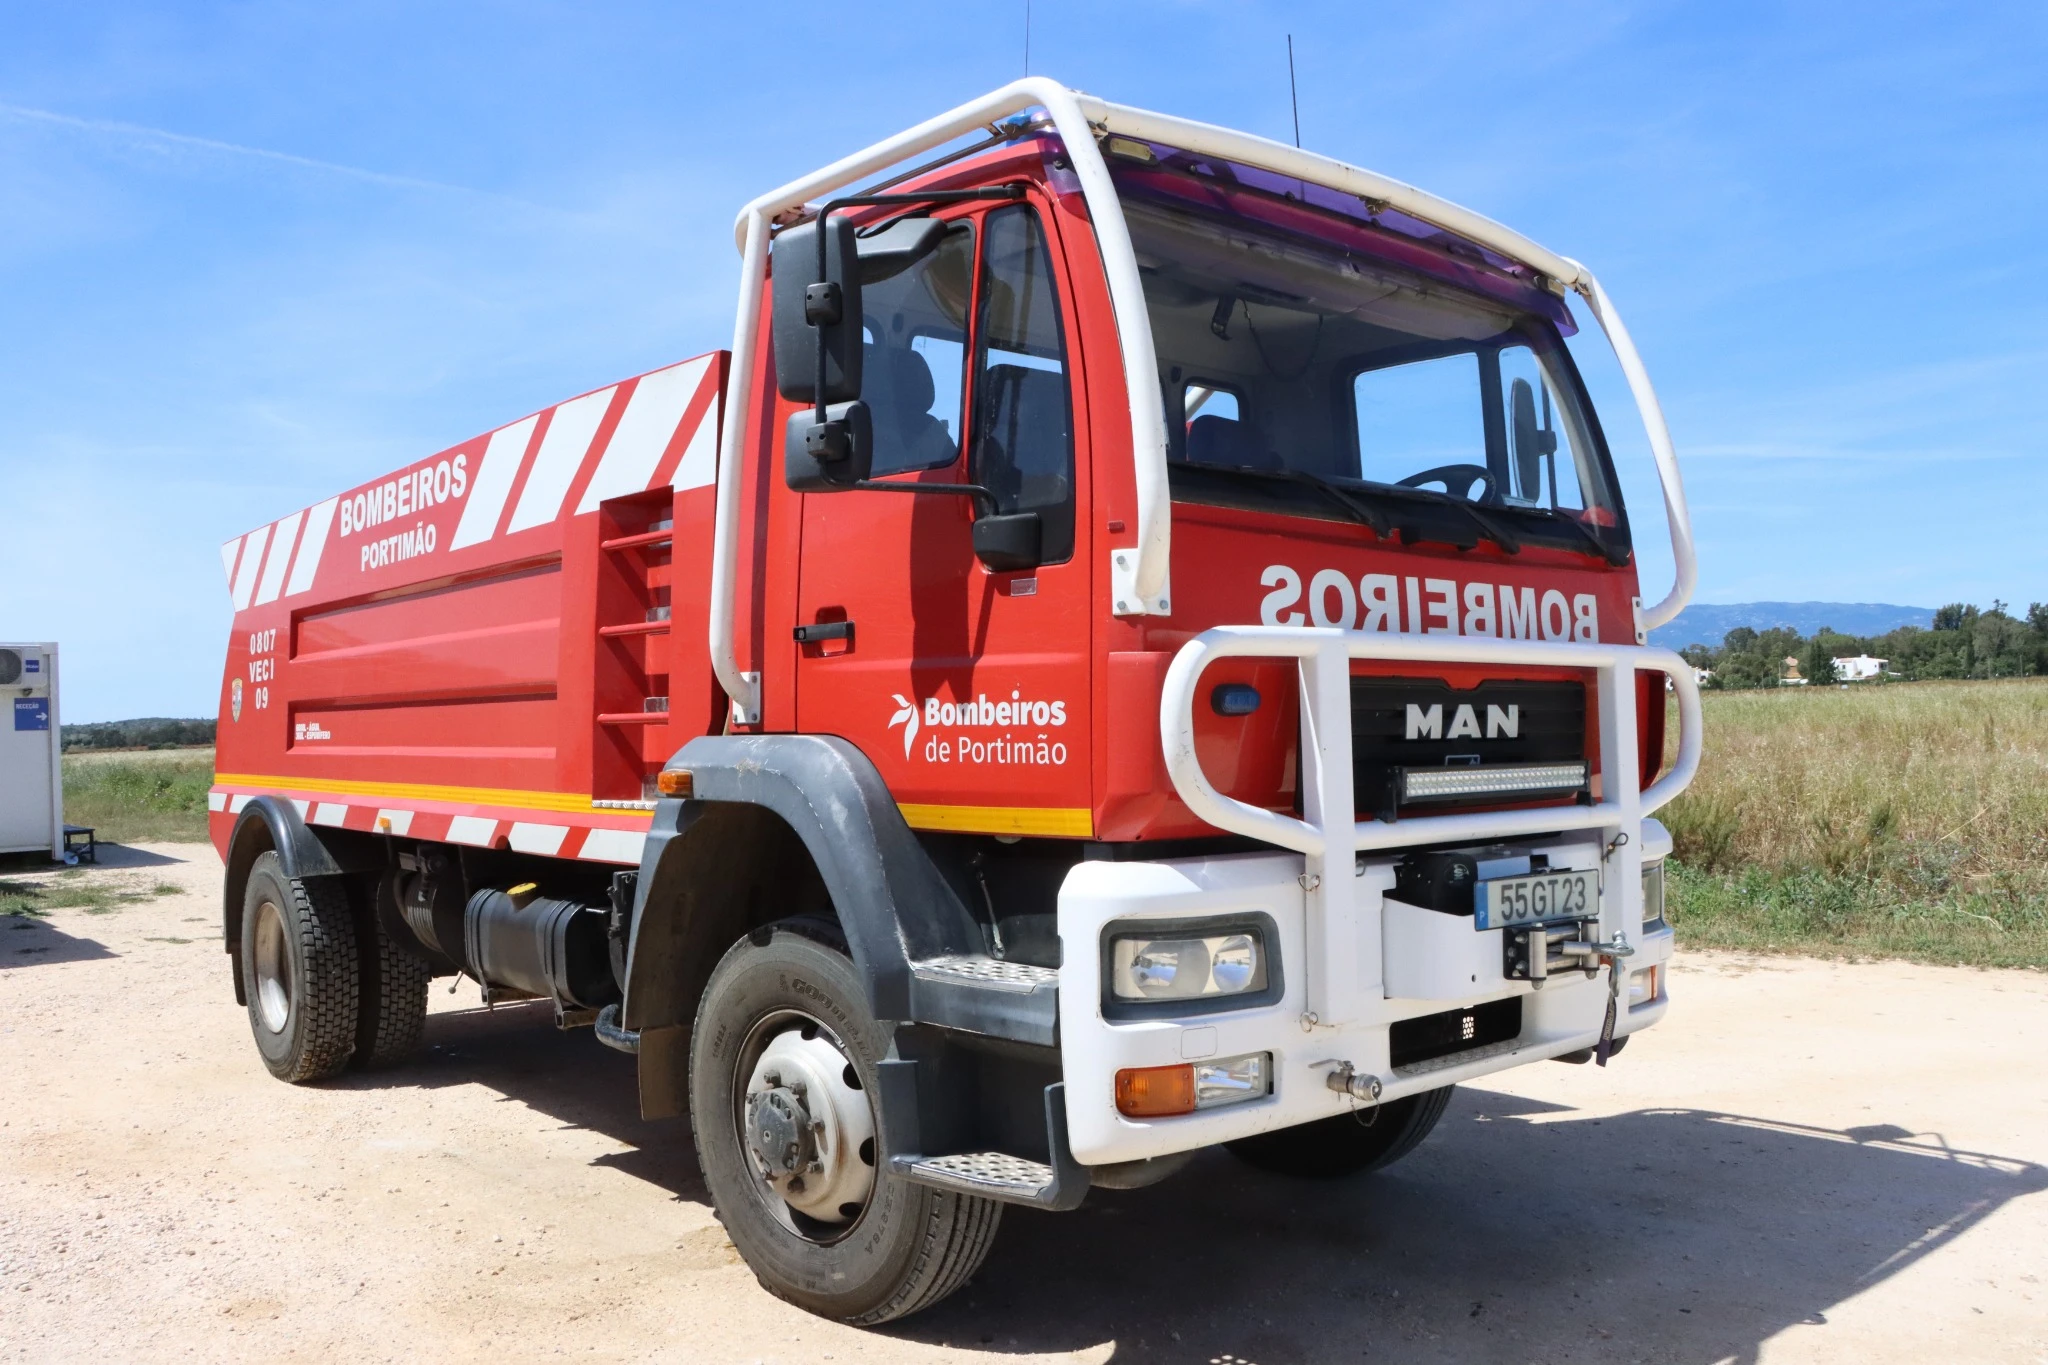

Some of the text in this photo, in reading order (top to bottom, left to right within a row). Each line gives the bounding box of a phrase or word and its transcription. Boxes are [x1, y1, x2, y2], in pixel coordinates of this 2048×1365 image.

[340, 453, 467, 538] BOMBEIROS
[360, 520, 437, 572] PORTIMÃO
[249, 628, 276, 656] 0807
[255, 686, 269, 710] 09
[924, 689, 1067, 727] Bombeiros
[1405, 703, 1519, 740] MAN
[925, 733, 1067, 765] de Portimão
[1479, 910, 1486, 921] P
